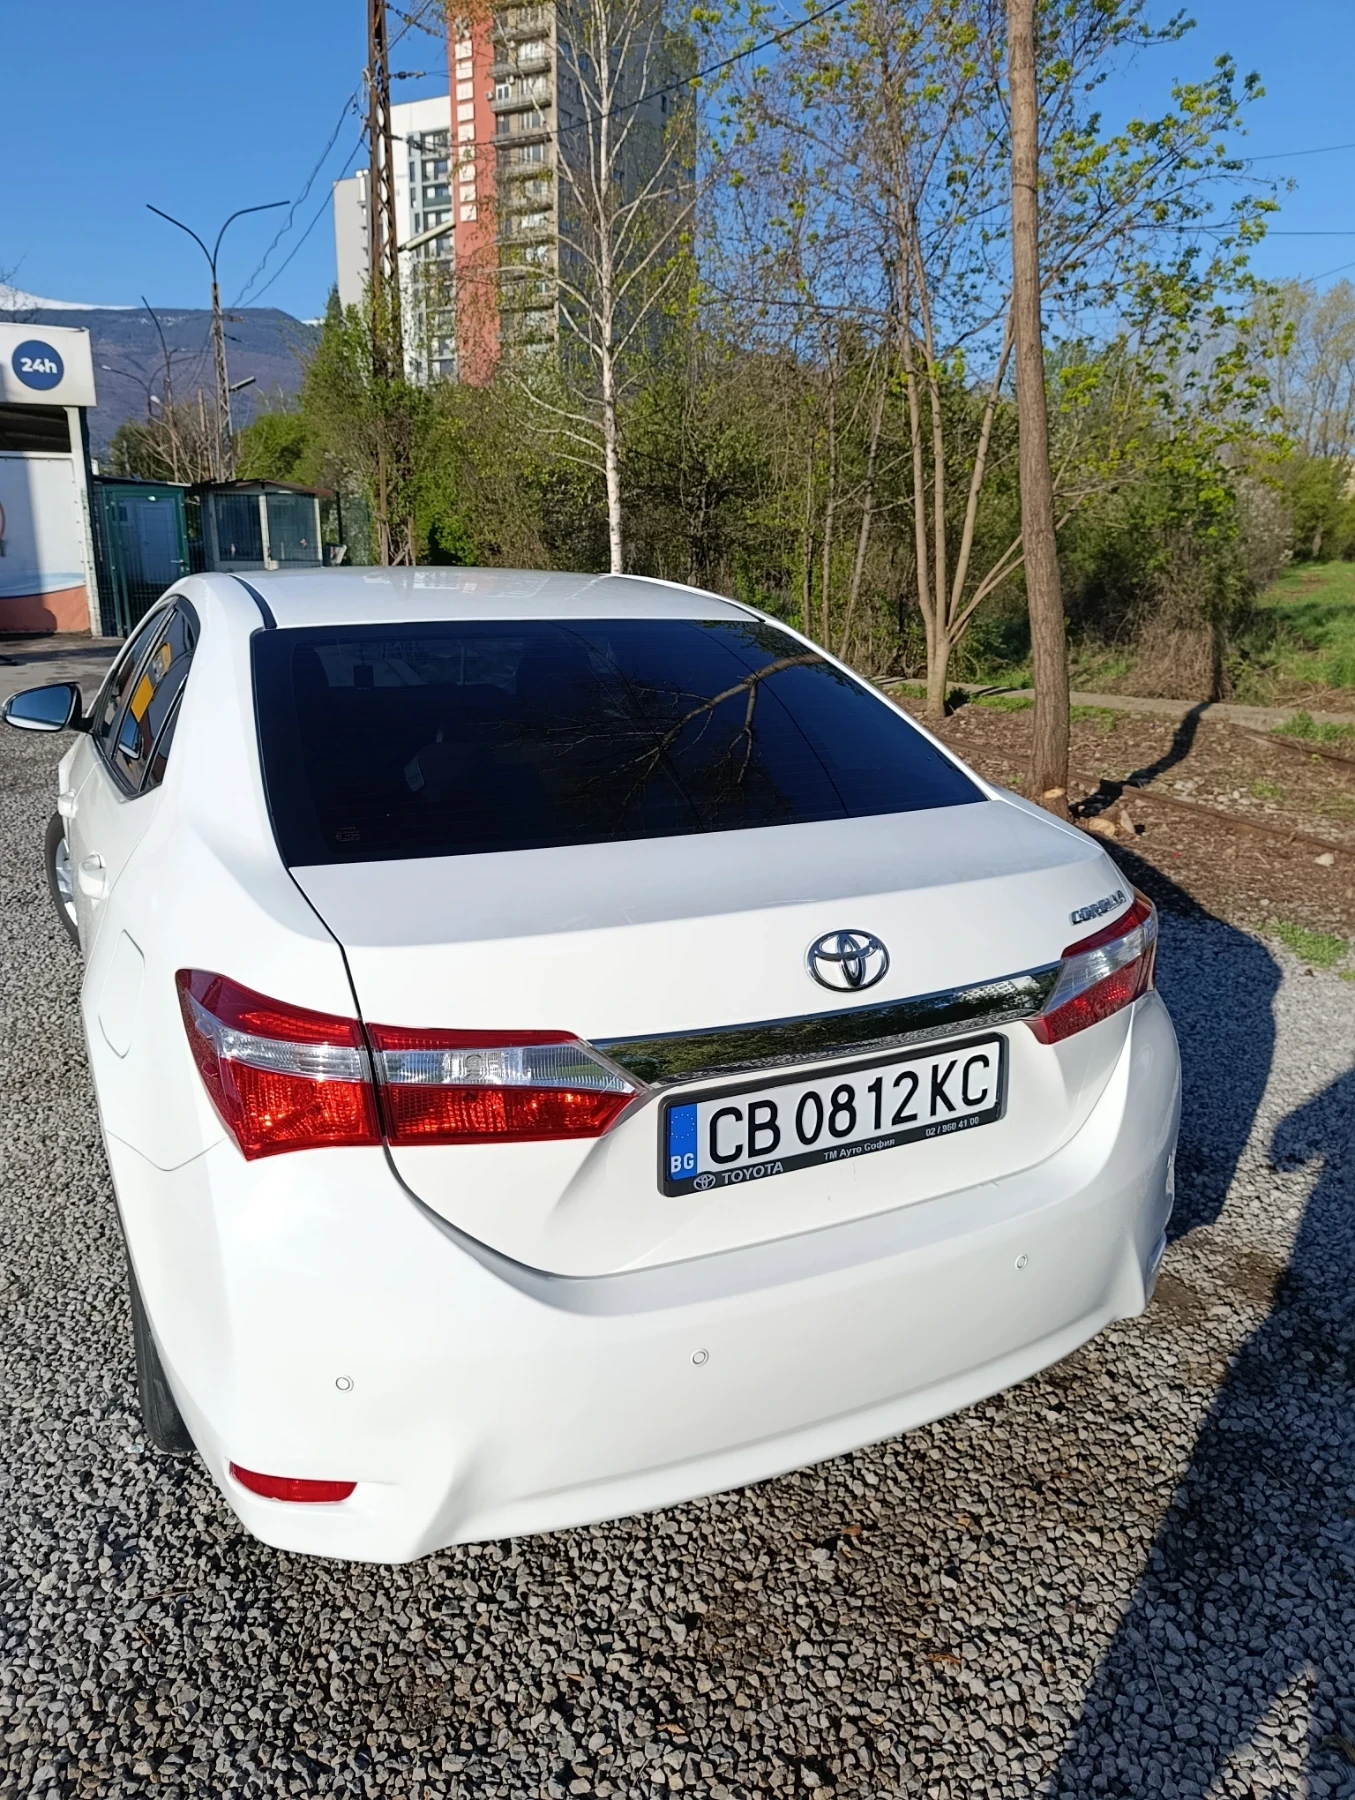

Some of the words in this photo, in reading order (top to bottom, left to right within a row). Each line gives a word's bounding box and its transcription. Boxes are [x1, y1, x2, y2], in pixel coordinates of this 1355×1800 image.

[20, 357, 58, 374] 24h
[1069, 890, 1126, 925] COROLLA
[708, 1099, 781, 1165] CB
[795, 1070, 920, 1145] 0812
[929, 1054, 990, 1117] KC
[925, 1127, 936, 1137] 02
[958, 1119, 968, 1128] 41
[969, 1116, 980, 1126] 00
[864, 1138, 896, 1150] София
[670, 1152, 696, 1174] BG
[721, 1161, 784, 1185] TOYOTA
